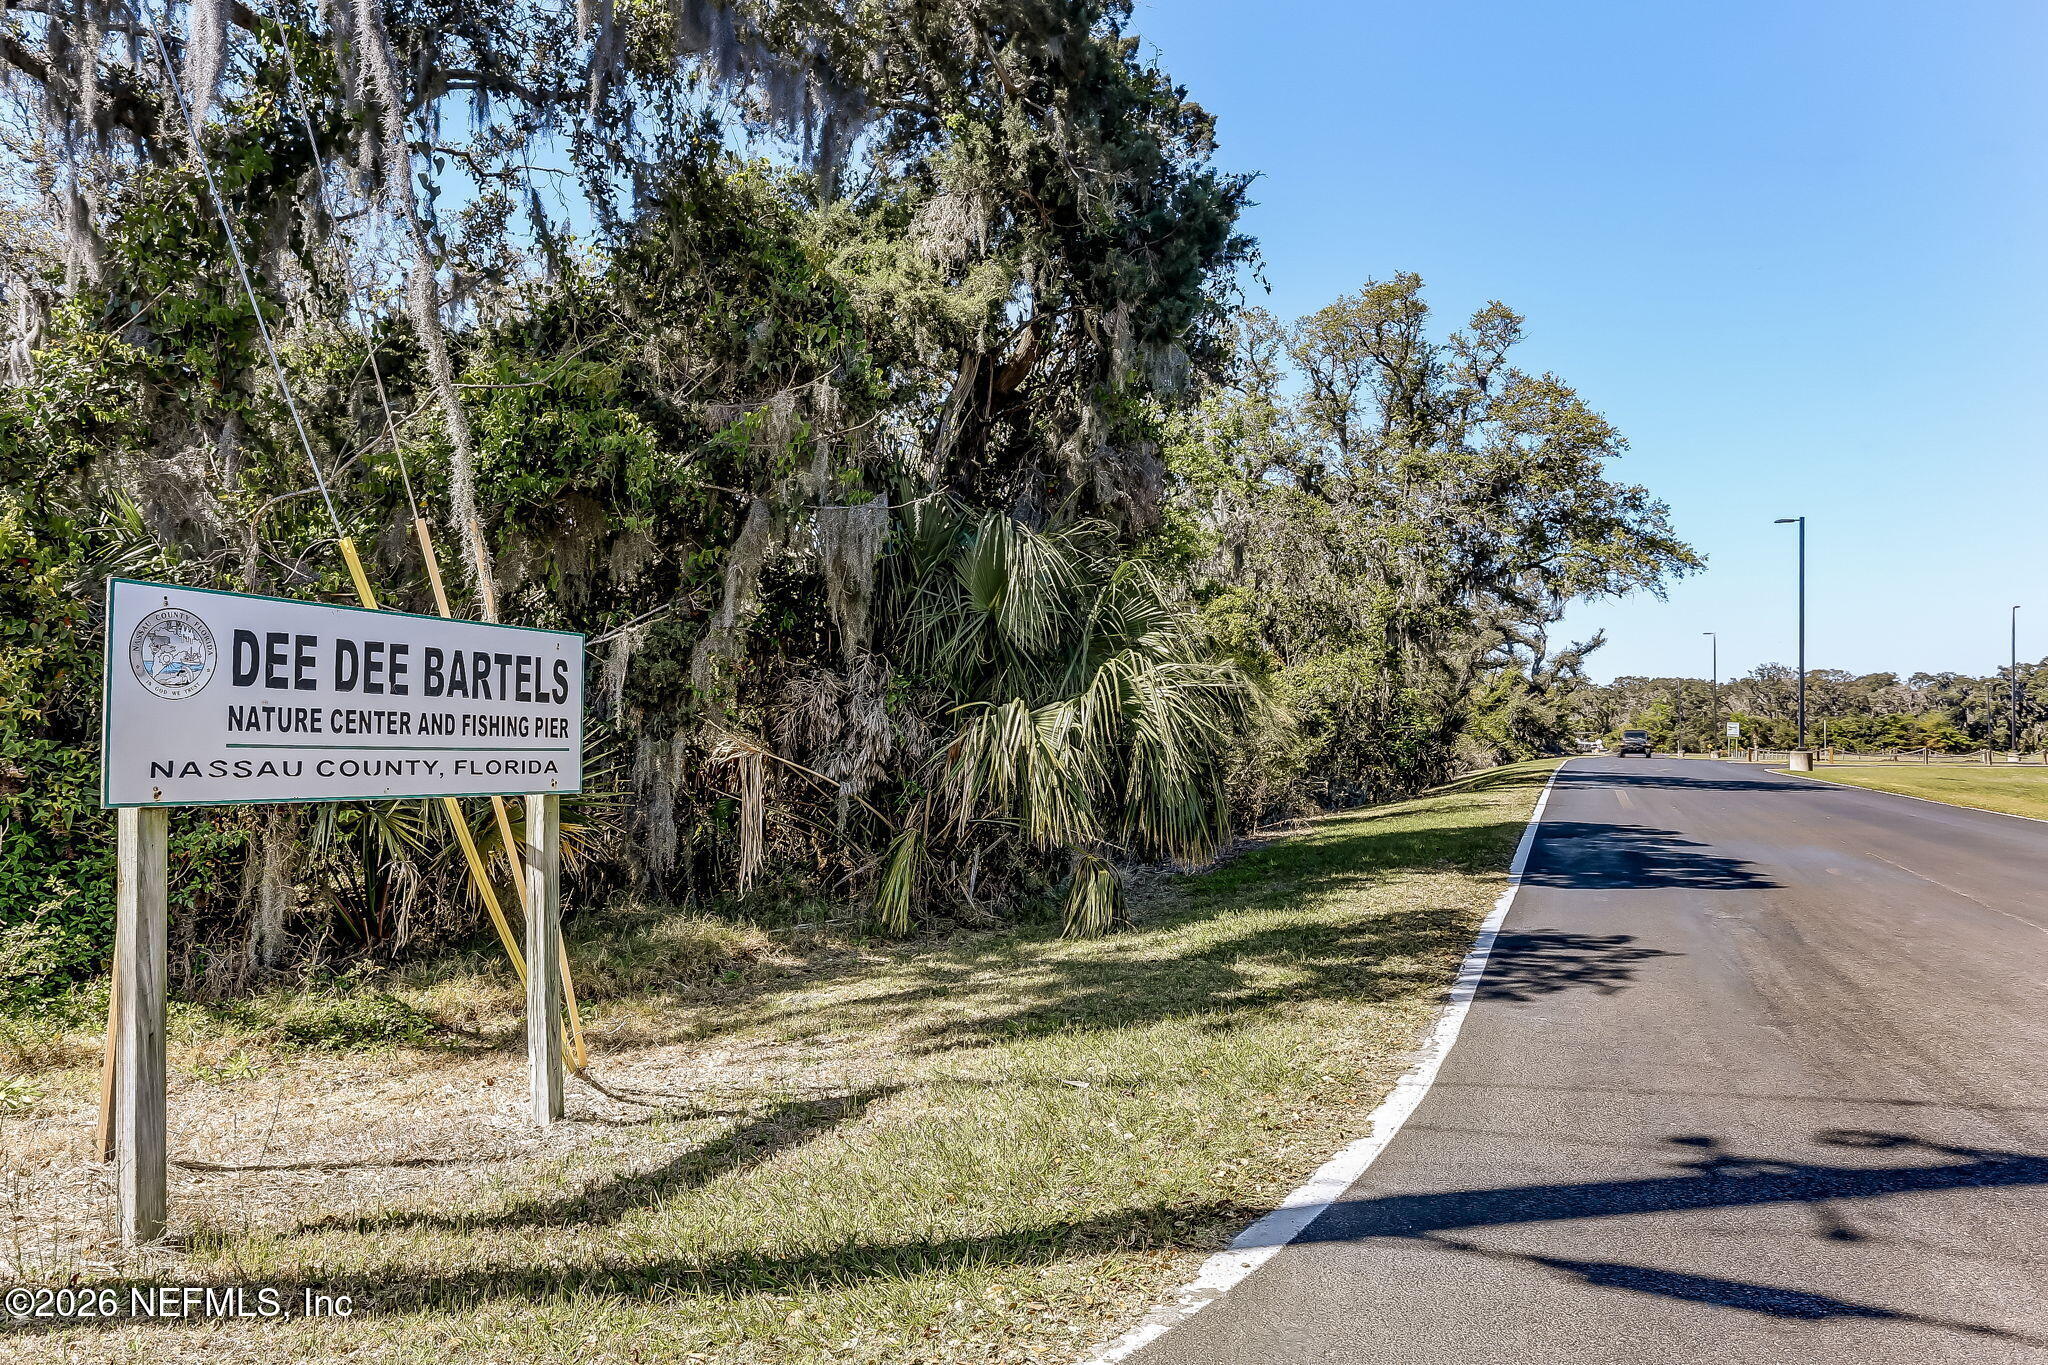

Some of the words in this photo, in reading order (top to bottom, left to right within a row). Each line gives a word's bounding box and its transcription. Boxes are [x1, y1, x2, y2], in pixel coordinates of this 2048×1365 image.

[132, 620, 152, 652] NASSAU
[155, 612, 190, 621] COUNTY
[194, 621, 214, 656] FLORIDA
[232, 629, 318, 691] DEE
[334, 638, 409, 696] DEE
[424, 647, 569, 705] BARTELS
[154, 687, 168, 695] GOD
[184, 682, 200, 694] TRUST
[227, 705, 322, 735] NATURE
[330, 708, 411, 736] CENTER
[417, 712, 455, 737] AND
[462, 714, 528, 738] FISHING
[534, 717, 569, 739] PIER
[149, 760, 303, 779] NASSAU
[316, 759, 444, 779] COUNTY,
[454, 758, 559, 776] FLORIDA
